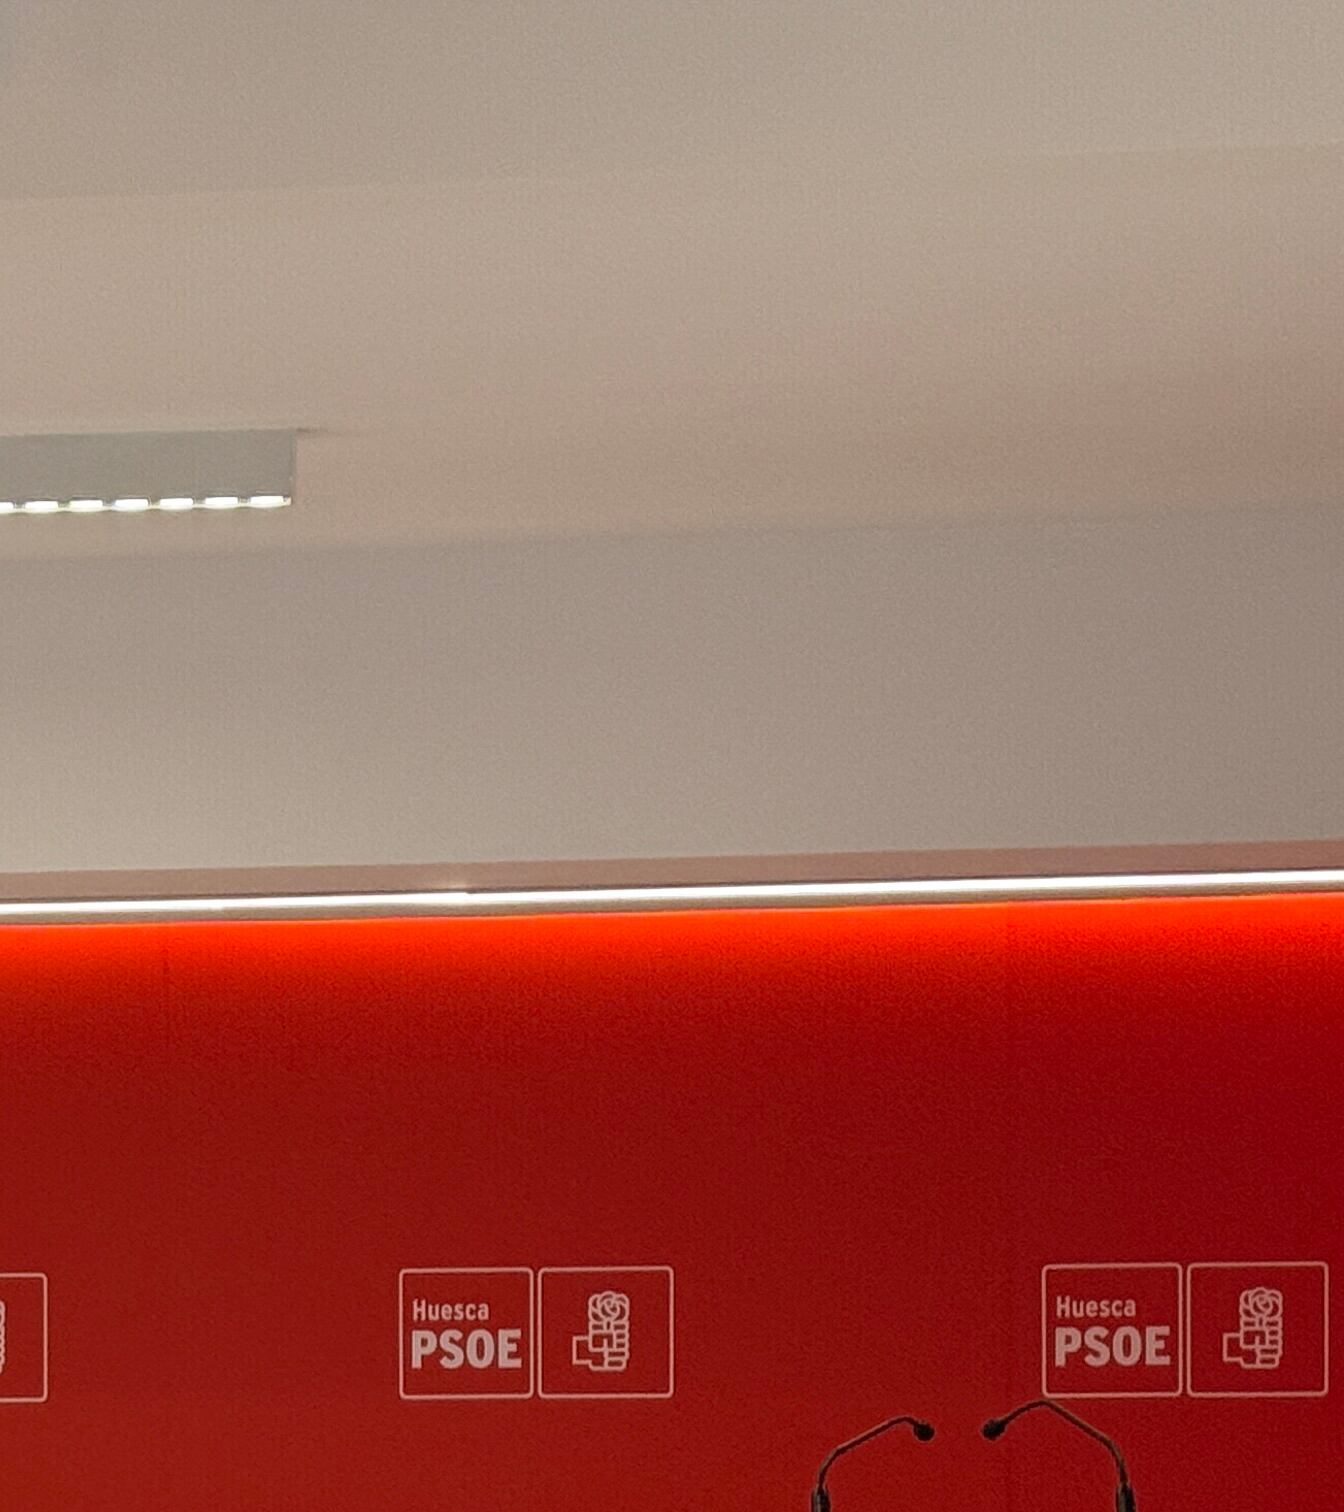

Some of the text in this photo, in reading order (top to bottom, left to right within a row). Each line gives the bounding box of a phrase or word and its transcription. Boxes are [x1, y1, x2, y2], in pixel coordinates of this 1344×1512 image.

[412, 1298, 489, 1322] Huesca
[1056, 1295, 1136, 1318] Huesca
[412, 1329, 522, 1369] PSOE
[1055, 1326, 1170, 1366] PSOE
